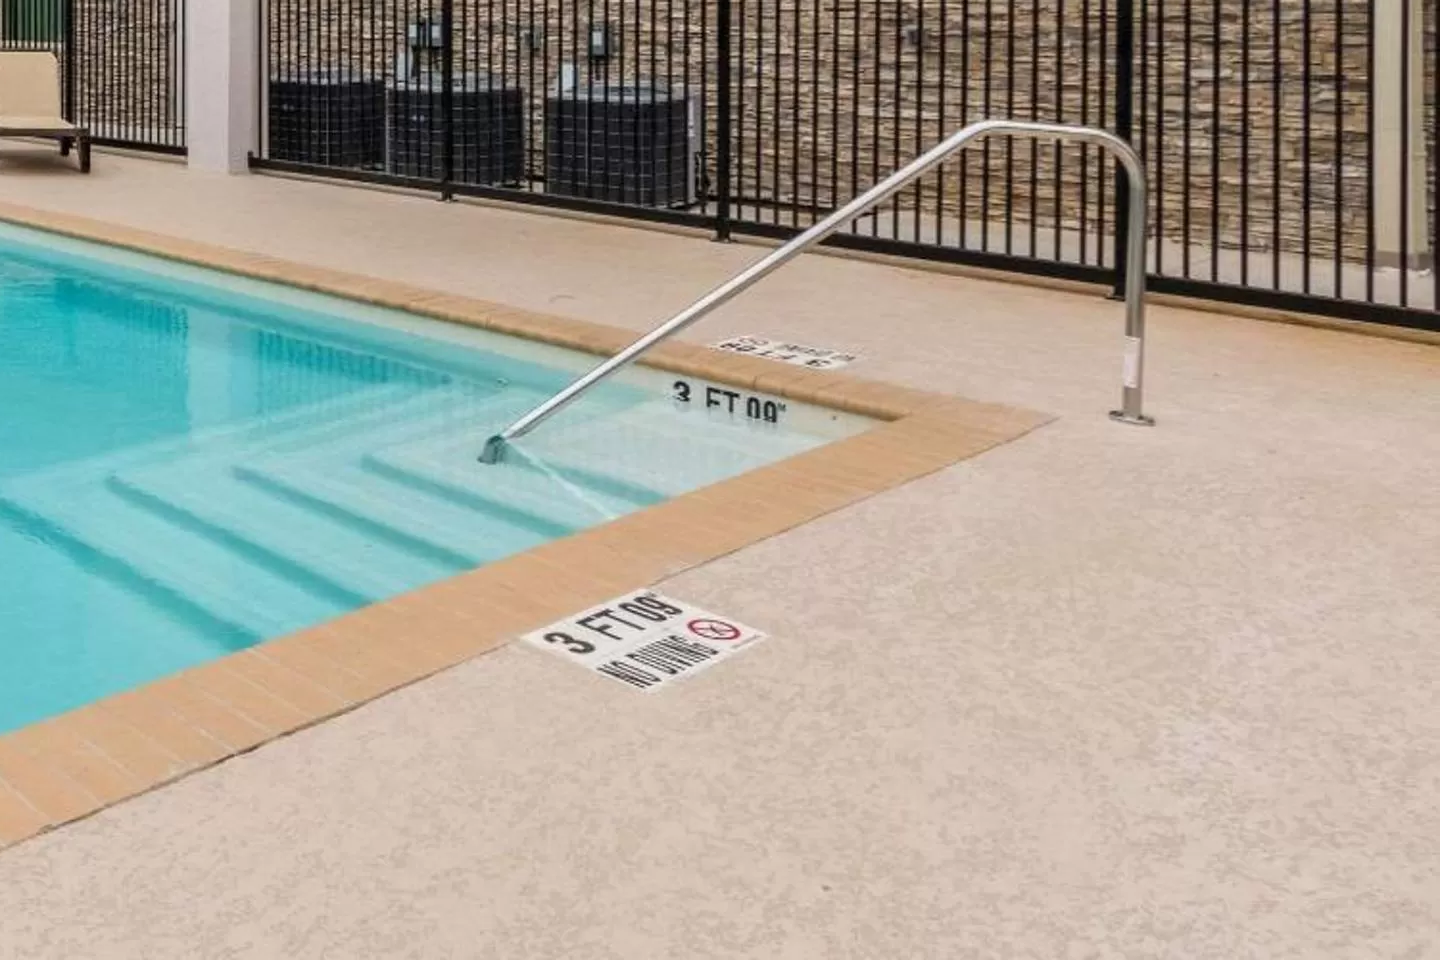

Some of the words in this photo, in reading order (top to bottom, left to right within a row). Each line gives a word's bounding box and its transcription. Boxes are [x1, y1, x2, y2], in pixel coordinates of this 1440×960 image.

[673, 380, 691, 402] 3
[706, 386, 740, 413] FT
[543, 631, 597, 655] 3
[575, 608, 646, 641] FT
[624, 634, 720, 676] DIVING
[596, 659, 663, 689] NO
